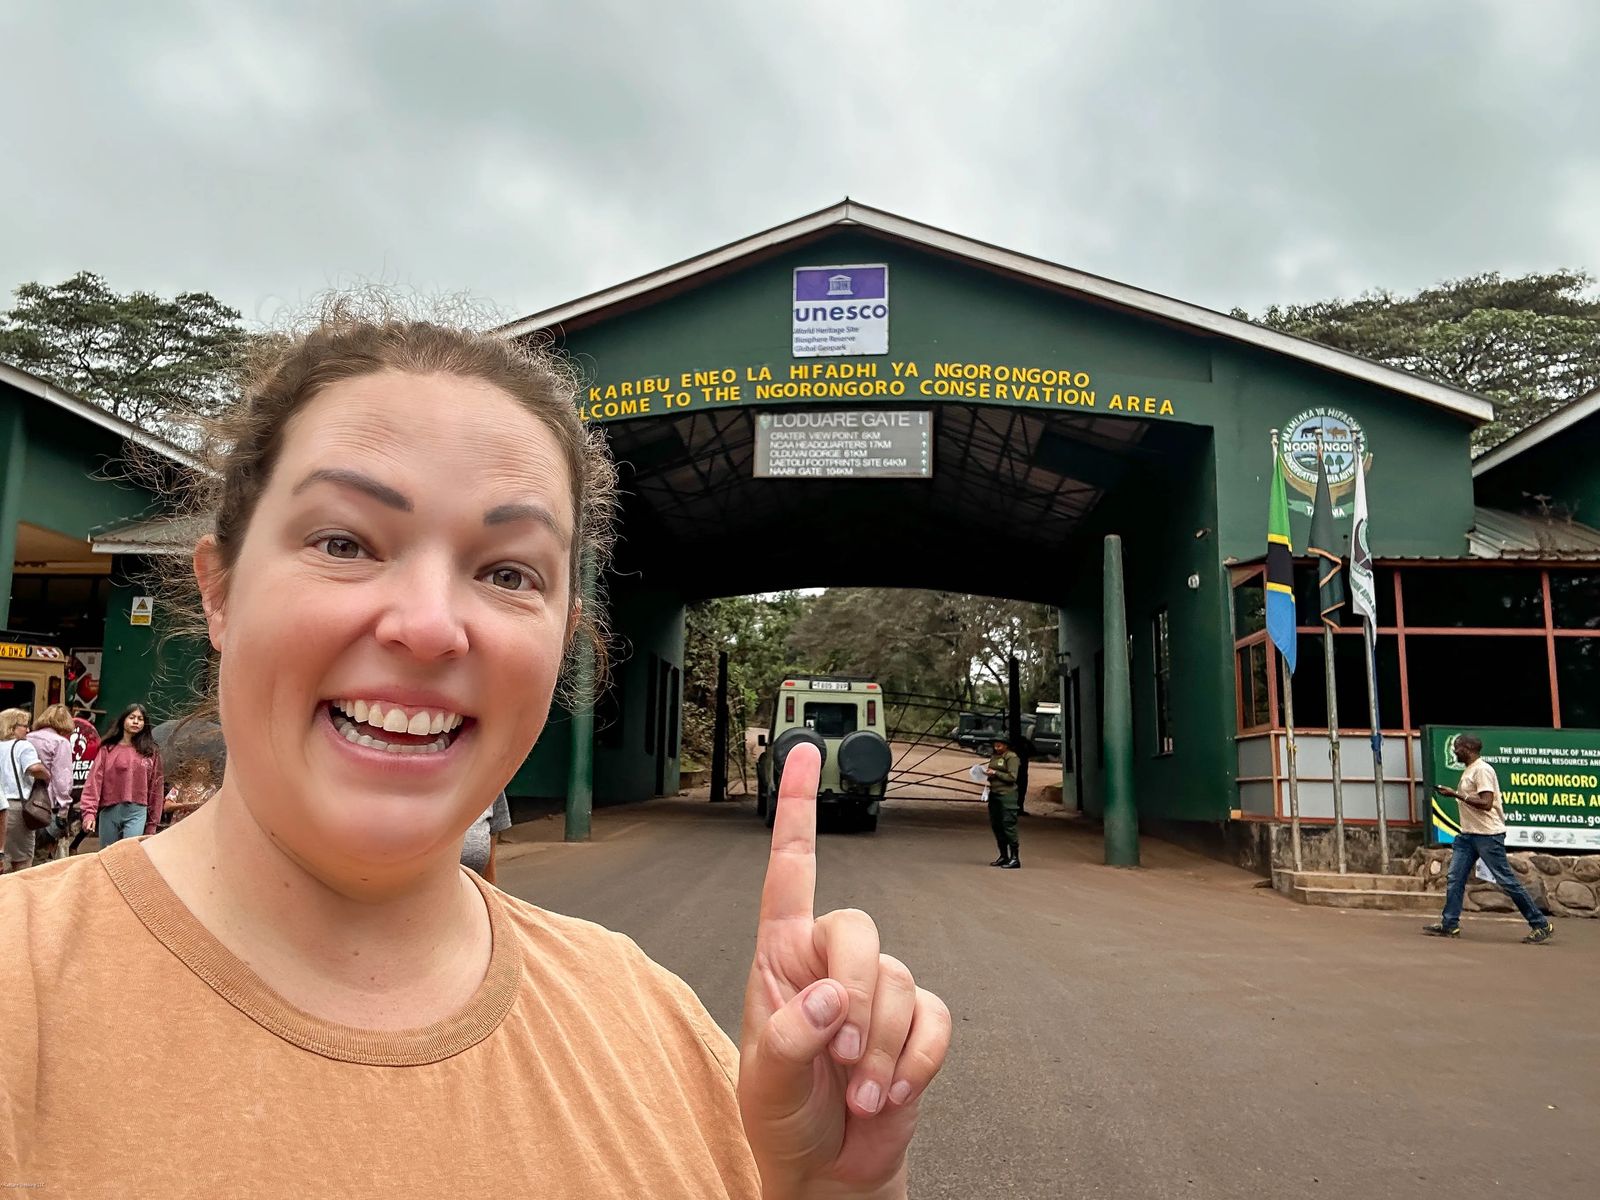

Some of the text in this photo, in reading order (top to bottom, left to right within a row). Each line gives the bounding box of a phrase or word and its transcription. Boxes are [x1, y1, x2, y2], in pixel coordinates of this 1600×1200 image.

[795, 304, 887, 322] unesco
[589, 362, 1090, 402] KARIBU ENEO LA HIFADHI YA NGORONGORO
[580, 380, 1175, 421] LCOME TO THE NGORONGORO CONSERVATION AREA
[774, 412, 911, 428] LODUARE GATE
[770, 432, 806, 440] CRATER
[795, 441, 867, 449] HEADQUARTERS
[806, 459, 861, 467] FOOTPRINTS
[1514, 747, 1537, 755] UNITED
[1539, 748, 1569, 756] REPUBLIC
[1570, 748, 1579, 756] OF
[1511, 756, 1521, 764] OF
[1522, 757, 1551, 765] NATURAL
[1552, 758, 1588, 766] RESOURCES
[1510, 773, 1598, 788] NGORONGORO
[1502, 791, 1548, 806] VATION
[1552, 793, 1586, 807] AREA
